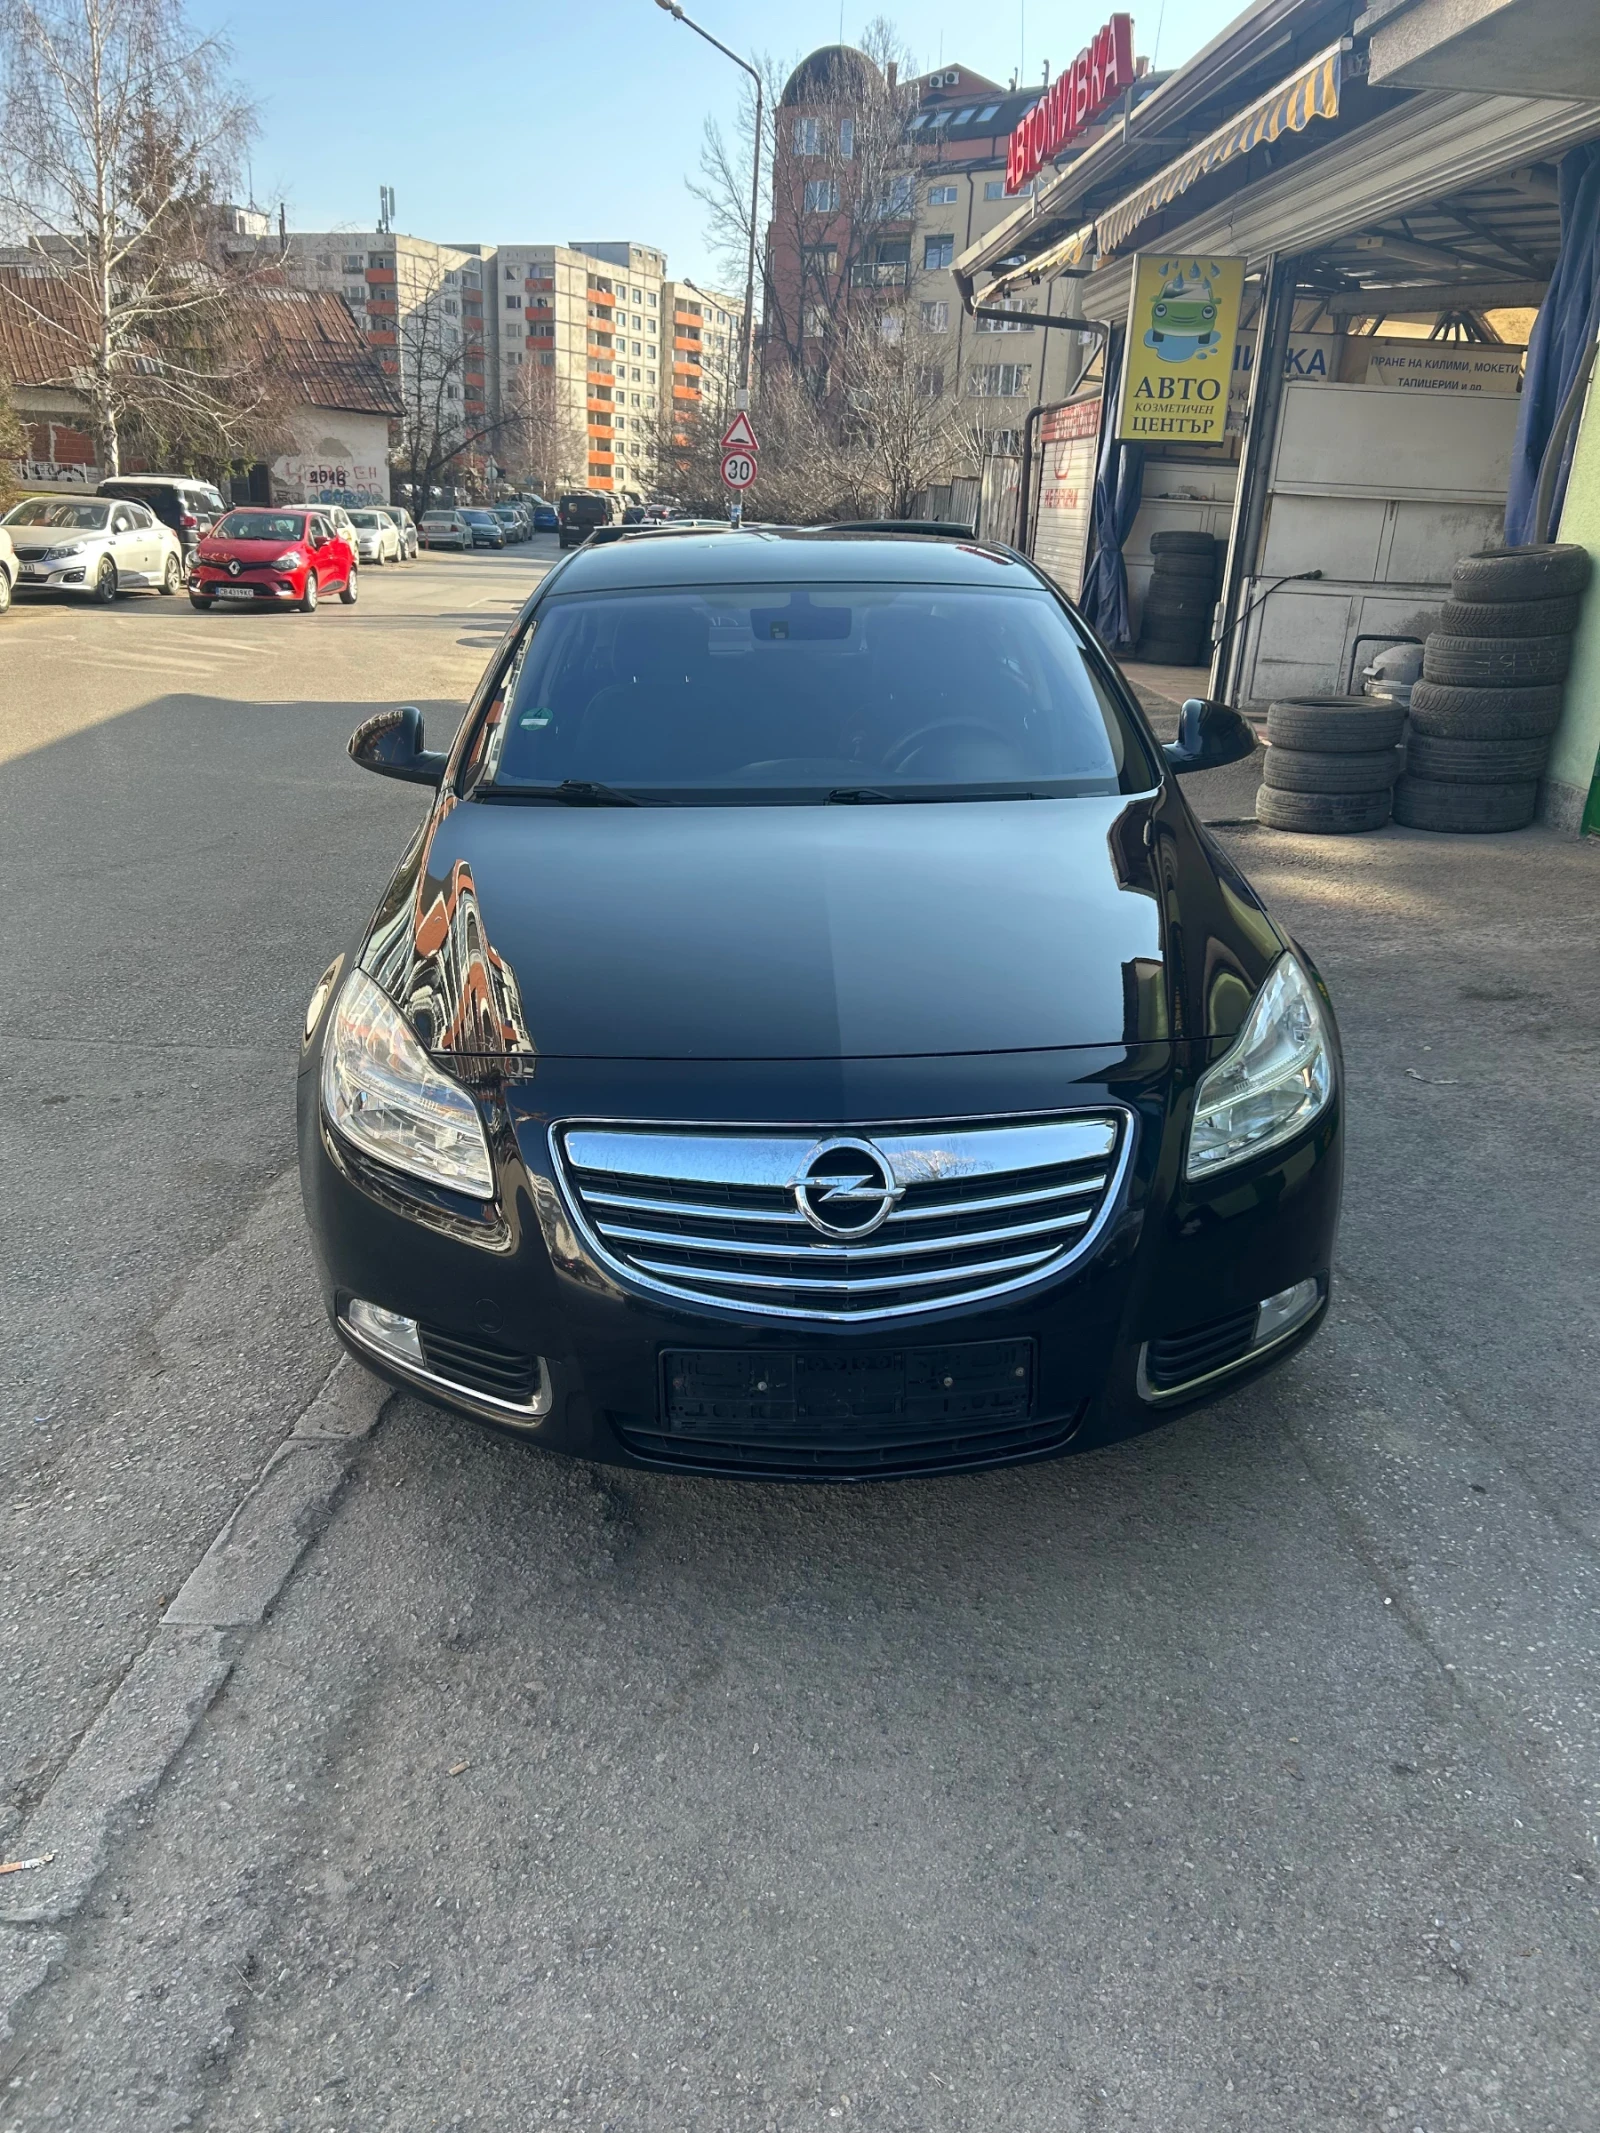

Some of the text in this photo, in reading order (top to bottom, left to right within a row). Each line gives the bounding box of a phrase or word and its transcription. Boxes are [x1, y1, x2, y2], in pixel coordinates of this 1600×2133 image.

[1006, 12, 1132, 194] АВТОМИВКА
[1371, 356, 1406, 367] ПРАНЕ
[1408, 358, 1422, 369] НА
[1425, 359, 1472, 373] КИЛИМИ,
[1133, 376, 1221, 401] АВТО
[1398, 377, 1459, 390] ТАПИЦЕРИИ
[1135, 403, 1215, 415] КОЗМЕТИЧЕН
[1132, 416, 1214, 435] ЦЕНТЪР
[728, 460, 749, 480] 30
